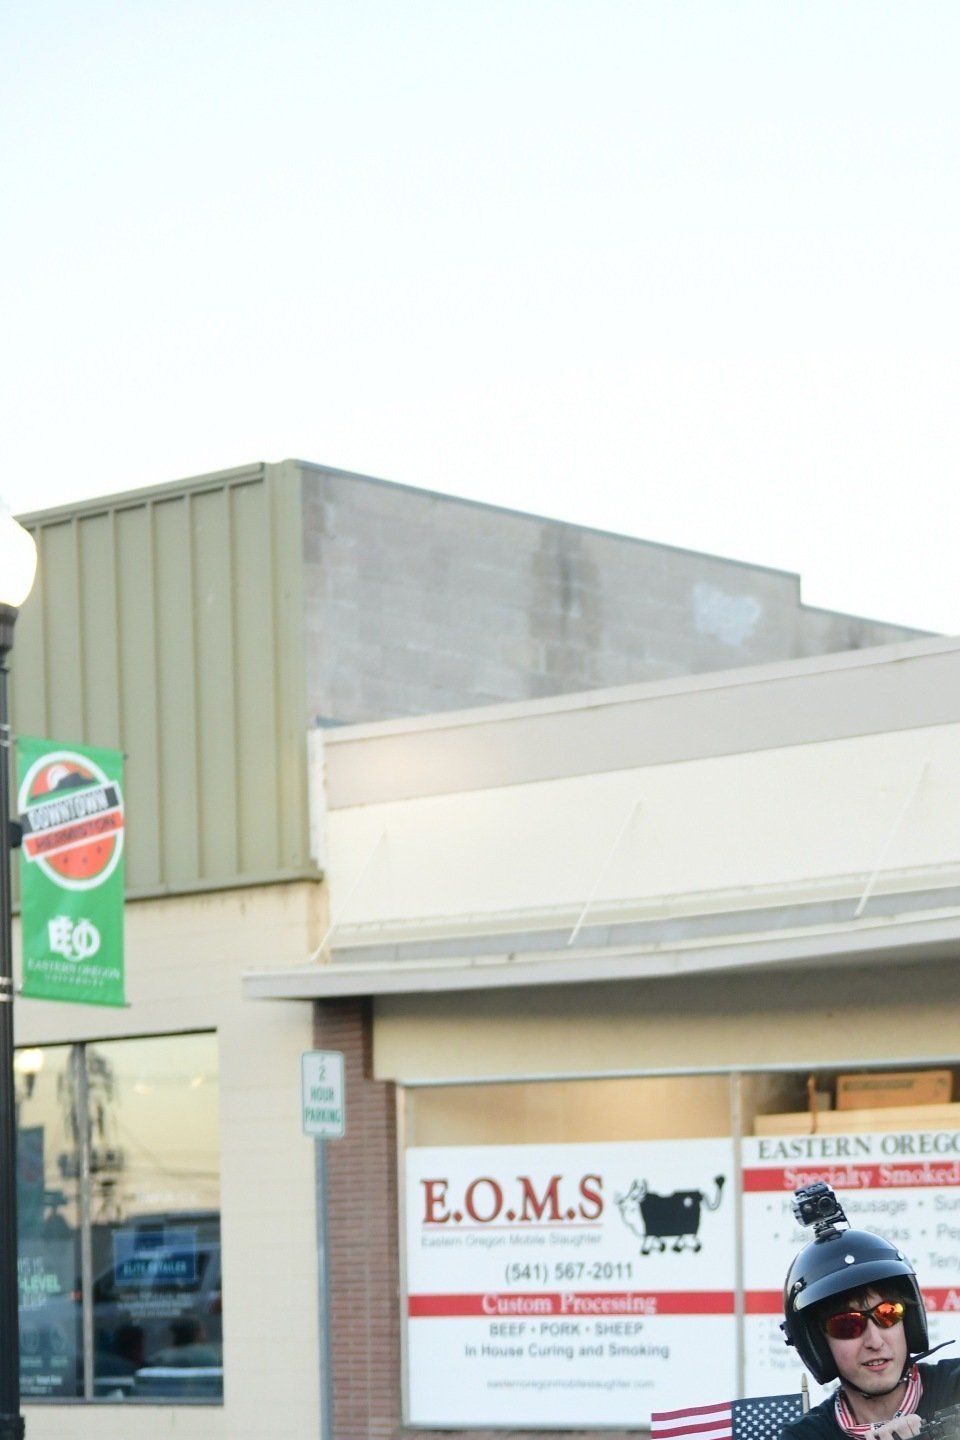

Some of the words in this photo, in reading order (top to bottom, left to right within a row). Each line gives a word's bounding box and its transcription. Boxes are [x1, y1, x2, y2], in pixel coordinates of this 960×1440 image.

[28, 787, 109, 832] DOWNTOWN
[319, 1066, 326, 1081] 2
[311, 1086, 334, 1101] HOUR
[305, 1107, 341, 1122] PARKING
[759, 1136, 872, 1159] EASTERN
[784, 1166, 872, 1190] Specialty
[879, 1161, 960, 1186] Smoked
[420, 1174, 604, 1223] E.O.M.S
[421, 1235, 462, 1248] Eastern
[466, 1234, 505, 1250] Oregon
[509, 1233, 546, 1246] Mobile
[549, 1232, 602, 1247] Slaughter
[505, 1263, 548, 1284] (541)
[555, 1262, 633, 1280] 567-2011
[481, 1294, 553, 1315] Custom
[558, 1292, 657, 1315] Processing
[489, 1323, 526, 1337] BEEF
[540, 1322, 580, 1336] PORK
[595, 1321, 644, 1336] SHEEP
[465, 1344, 477, 1357] In
[481, 1344, 524, 1358] House
[528, 1343, 574, 1359] Curing
[578, 1343, 603, 1356] and
[608, 1342, 670, 1359] Smoking
